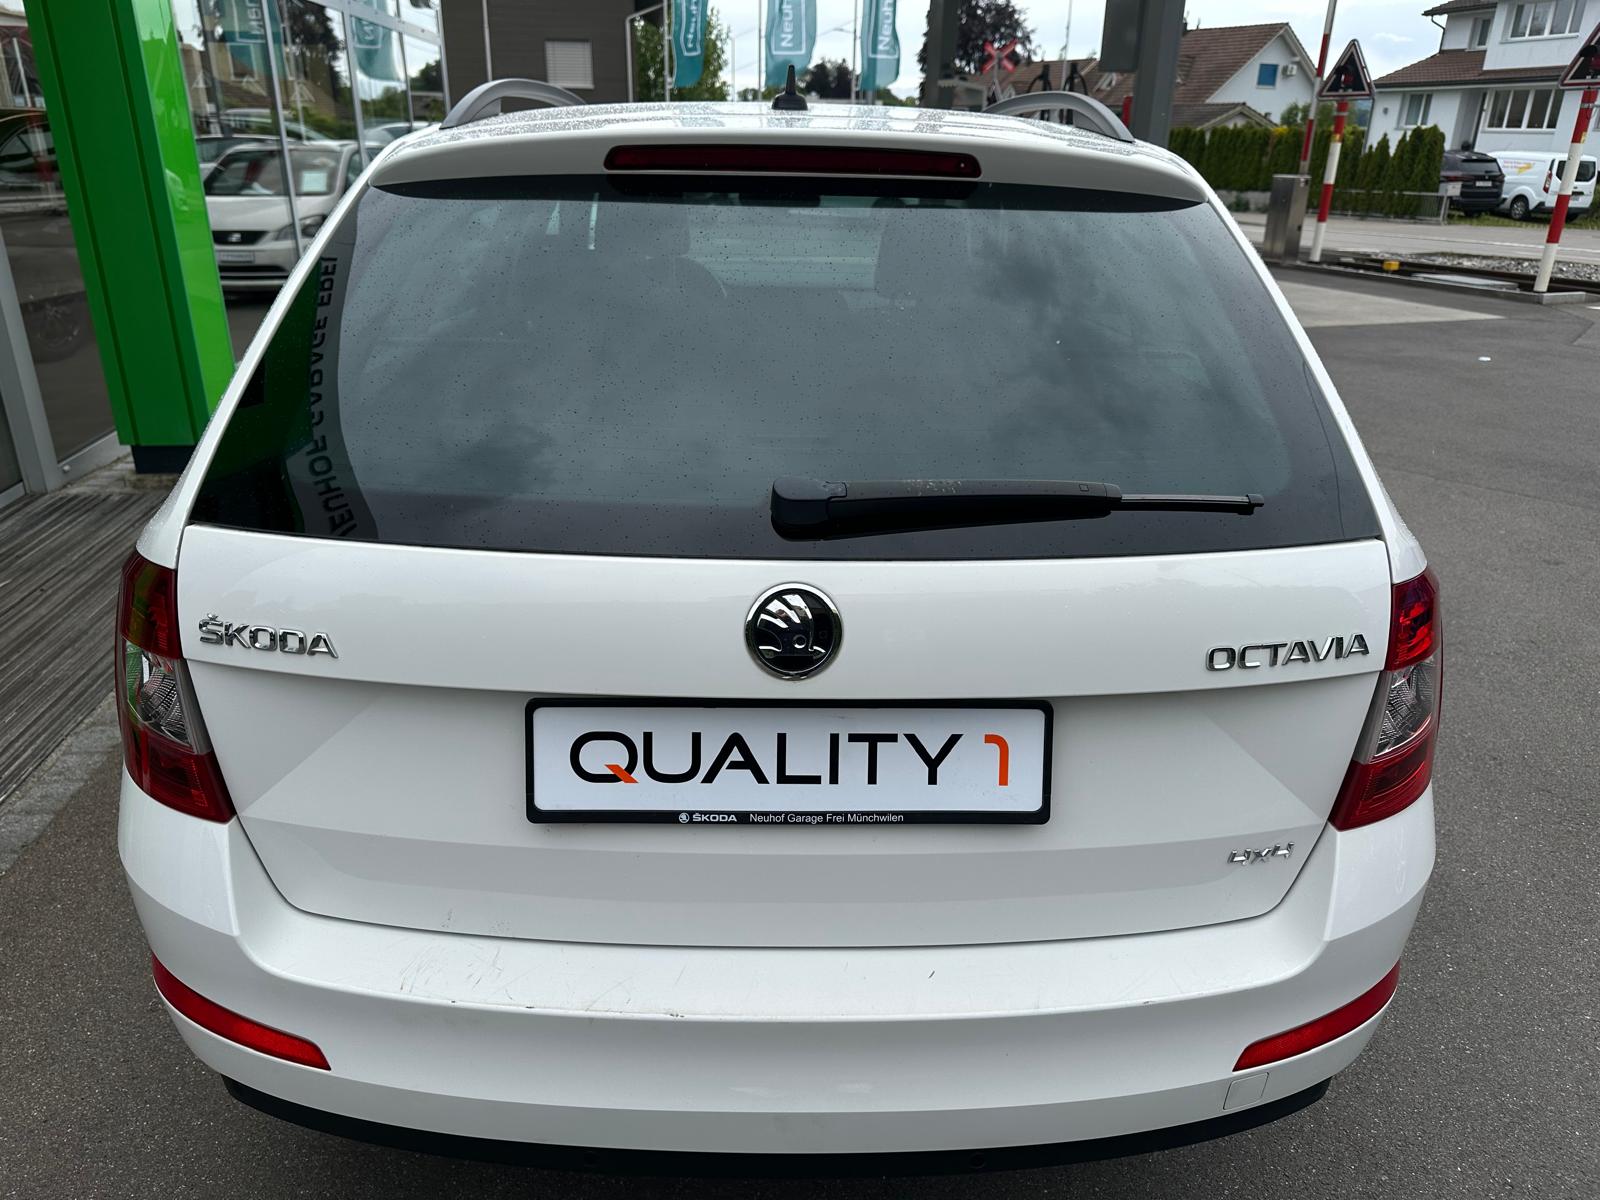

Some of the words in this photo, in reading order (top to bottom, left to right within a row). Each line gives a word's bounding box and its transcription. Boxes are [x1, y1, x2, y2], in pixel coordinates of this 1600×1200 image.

[198, 612, 340, 660] ŠKODA
[1205, 632, 1370, 672] OCTAVIA
[569, 730, 964, 786] QUALITY
[984, 733, 1010, 787] 1
[692, 812, 738, 823] ŠKODA
[749, 813, 786, 823] Neuhof
[787, 813, 824, 825] Garage
[826, 813, 846, 823] Frei
[847, 812, 905, 823] Münchwilen
